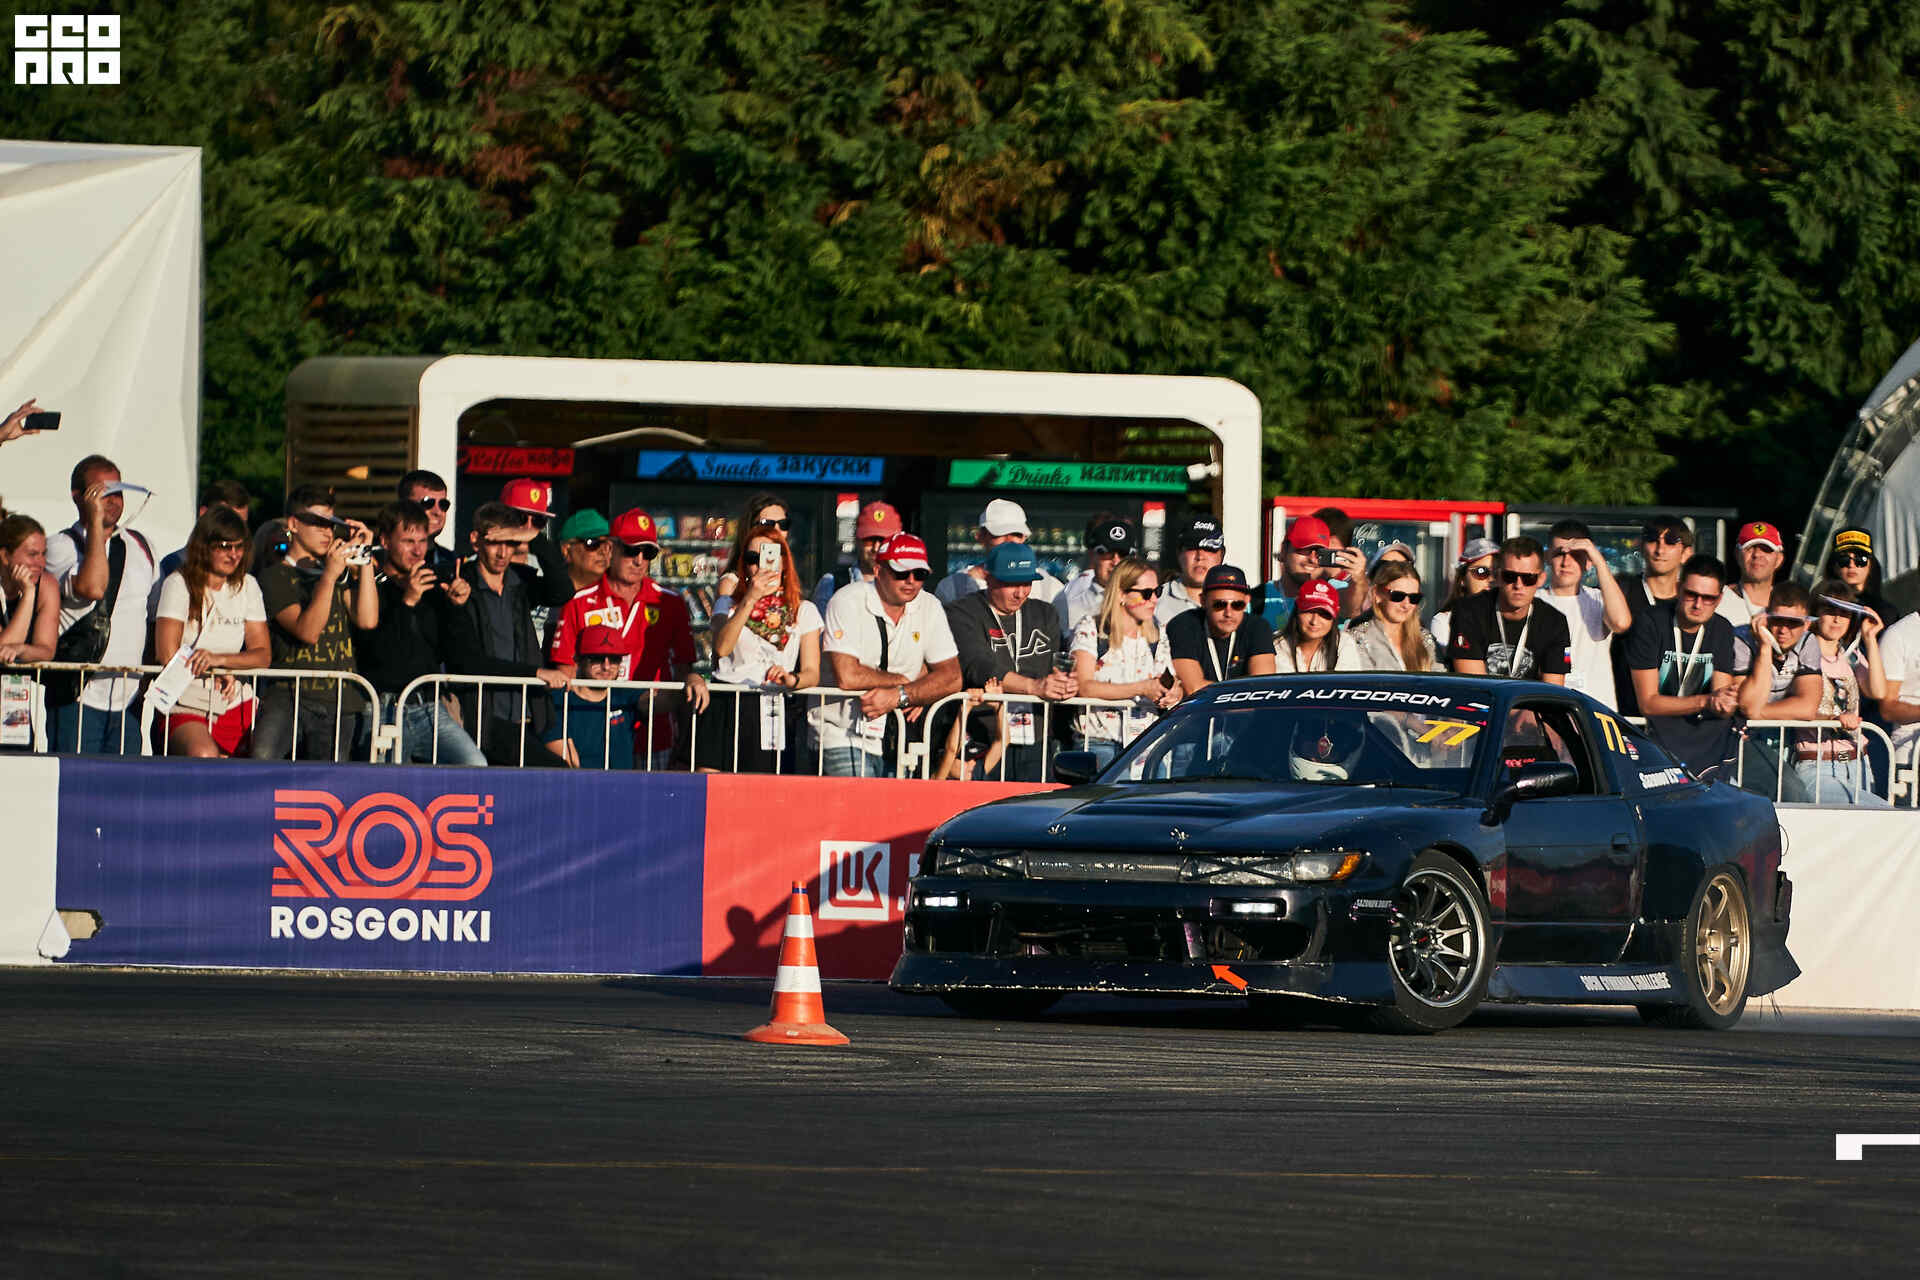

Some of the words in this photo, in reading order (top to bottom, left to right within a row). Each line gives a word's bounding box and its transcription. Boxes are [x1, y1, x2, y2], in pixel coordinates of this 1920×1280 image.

[702, 455, 769, 478] Snacks
[1008, 464, 1071, 487] Drinks
[1214, 689, 1292, 704] SOCHI
[1296, 688, 1452, 708] AUTODROM
[1415, 719, 1481, 746] 77
[1594, 711, 1626, 754] 77
[272, 789, 494, 901] ROS
[270, 906, 491, 943] ROSGONKI
